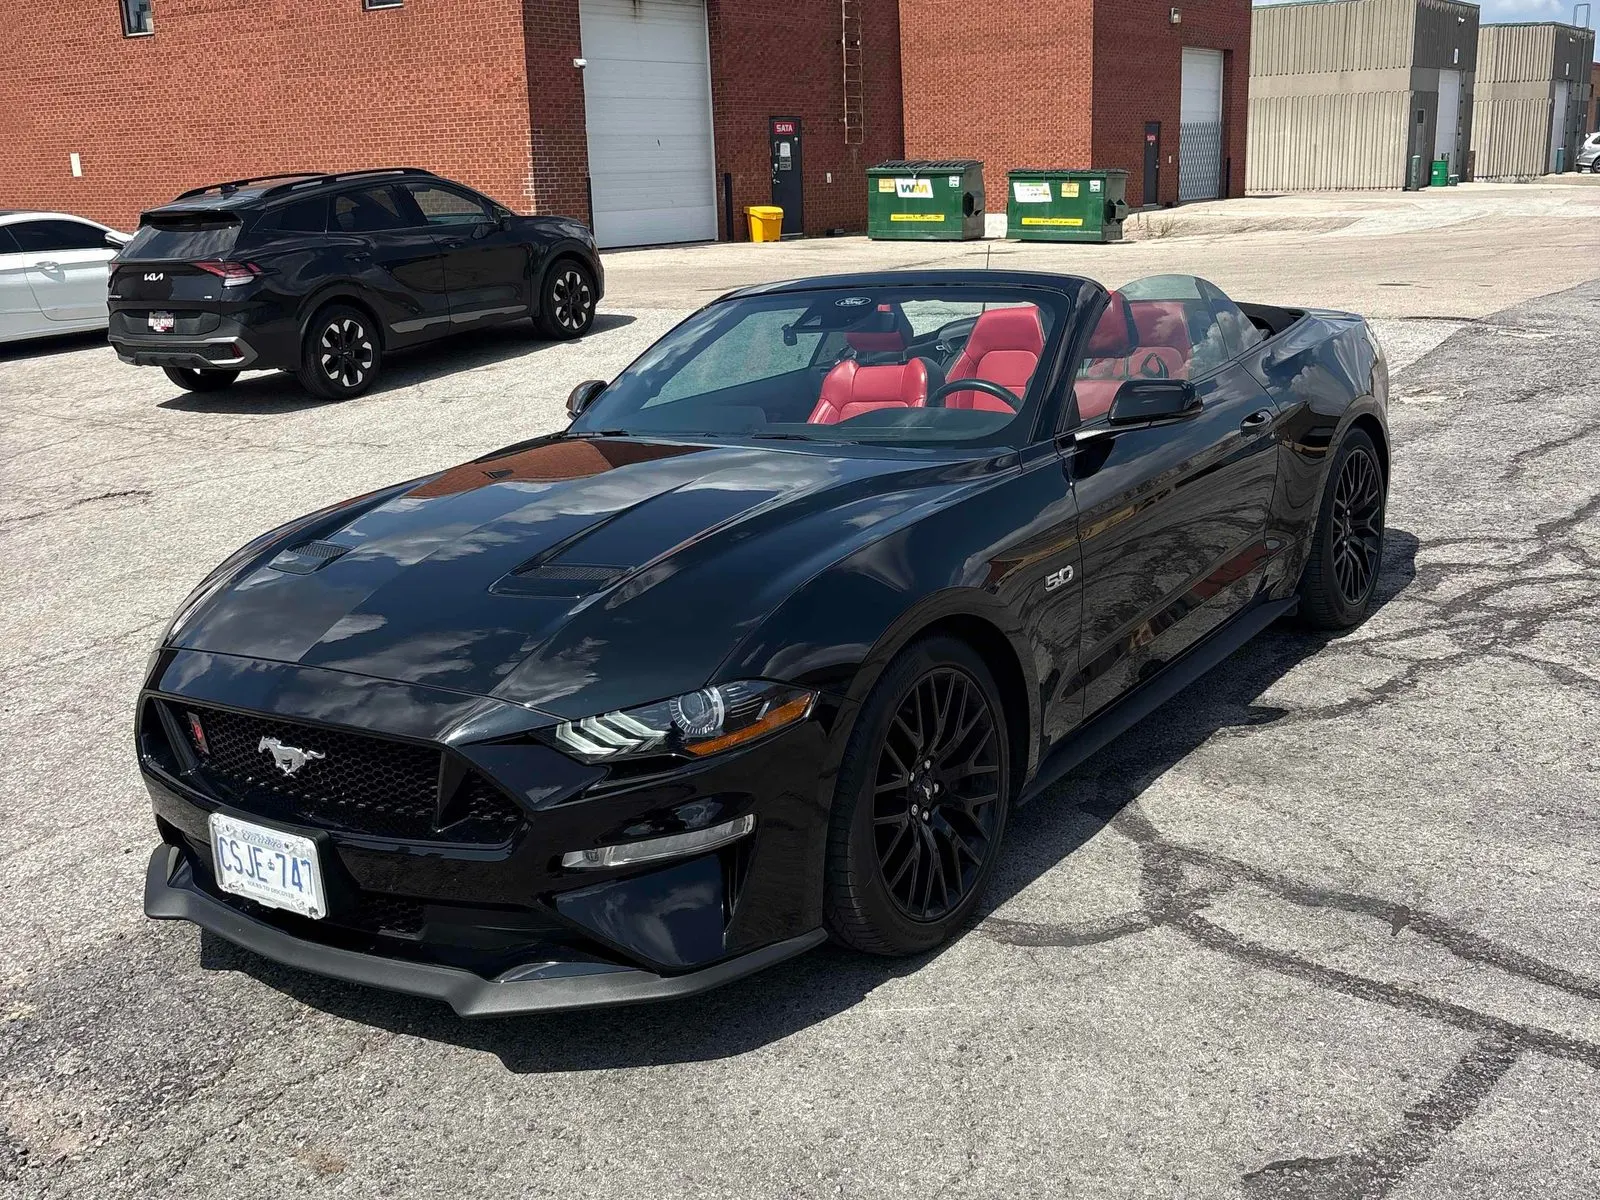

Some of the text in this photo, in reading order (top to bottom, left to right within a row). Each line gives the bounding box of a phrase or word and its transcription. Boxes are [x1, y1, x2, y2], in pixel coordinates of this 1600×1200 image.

[776, 124, 793, 132] SATA
[901, 184, 928, 193] WM
[143, 273, 164, 281] KIA
[839, 297, 867, 305] Ford
[1045, 565, 1074, 592] 5.0
[219, 836, 313, 895] CSJE 747
